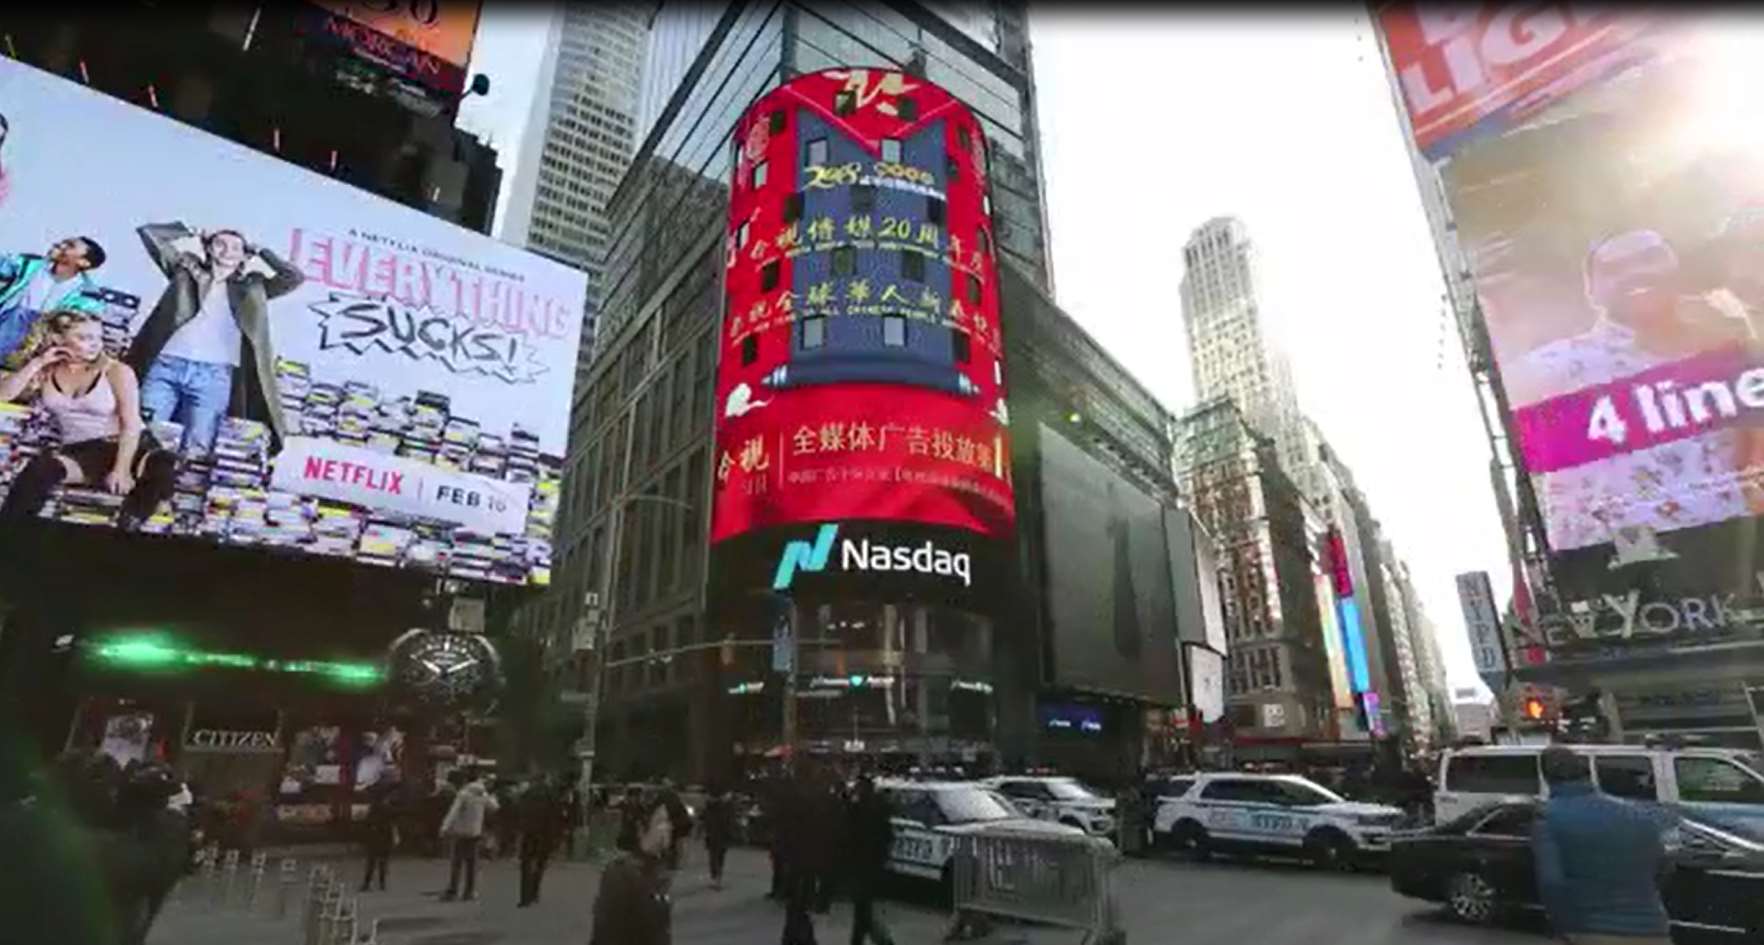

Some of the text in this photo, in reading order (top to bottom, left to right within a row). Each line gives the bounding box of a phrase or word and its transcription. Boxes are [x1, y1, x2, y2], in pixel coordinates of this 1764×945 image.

[360, 231, 419, 253] NETFLIX
[289, 228, 571, 340] EVERYTHING
[337, 302, 519, 374] SUCKS!
[1587, 367, 1764, 444] 4 line
[303, 456, 404, 495] NETFLIX
[436, 484, 481, 508] FEB
[842, 538, 971, 587] Nasdaq
[193, 728, 282, 748] CITIZEN
